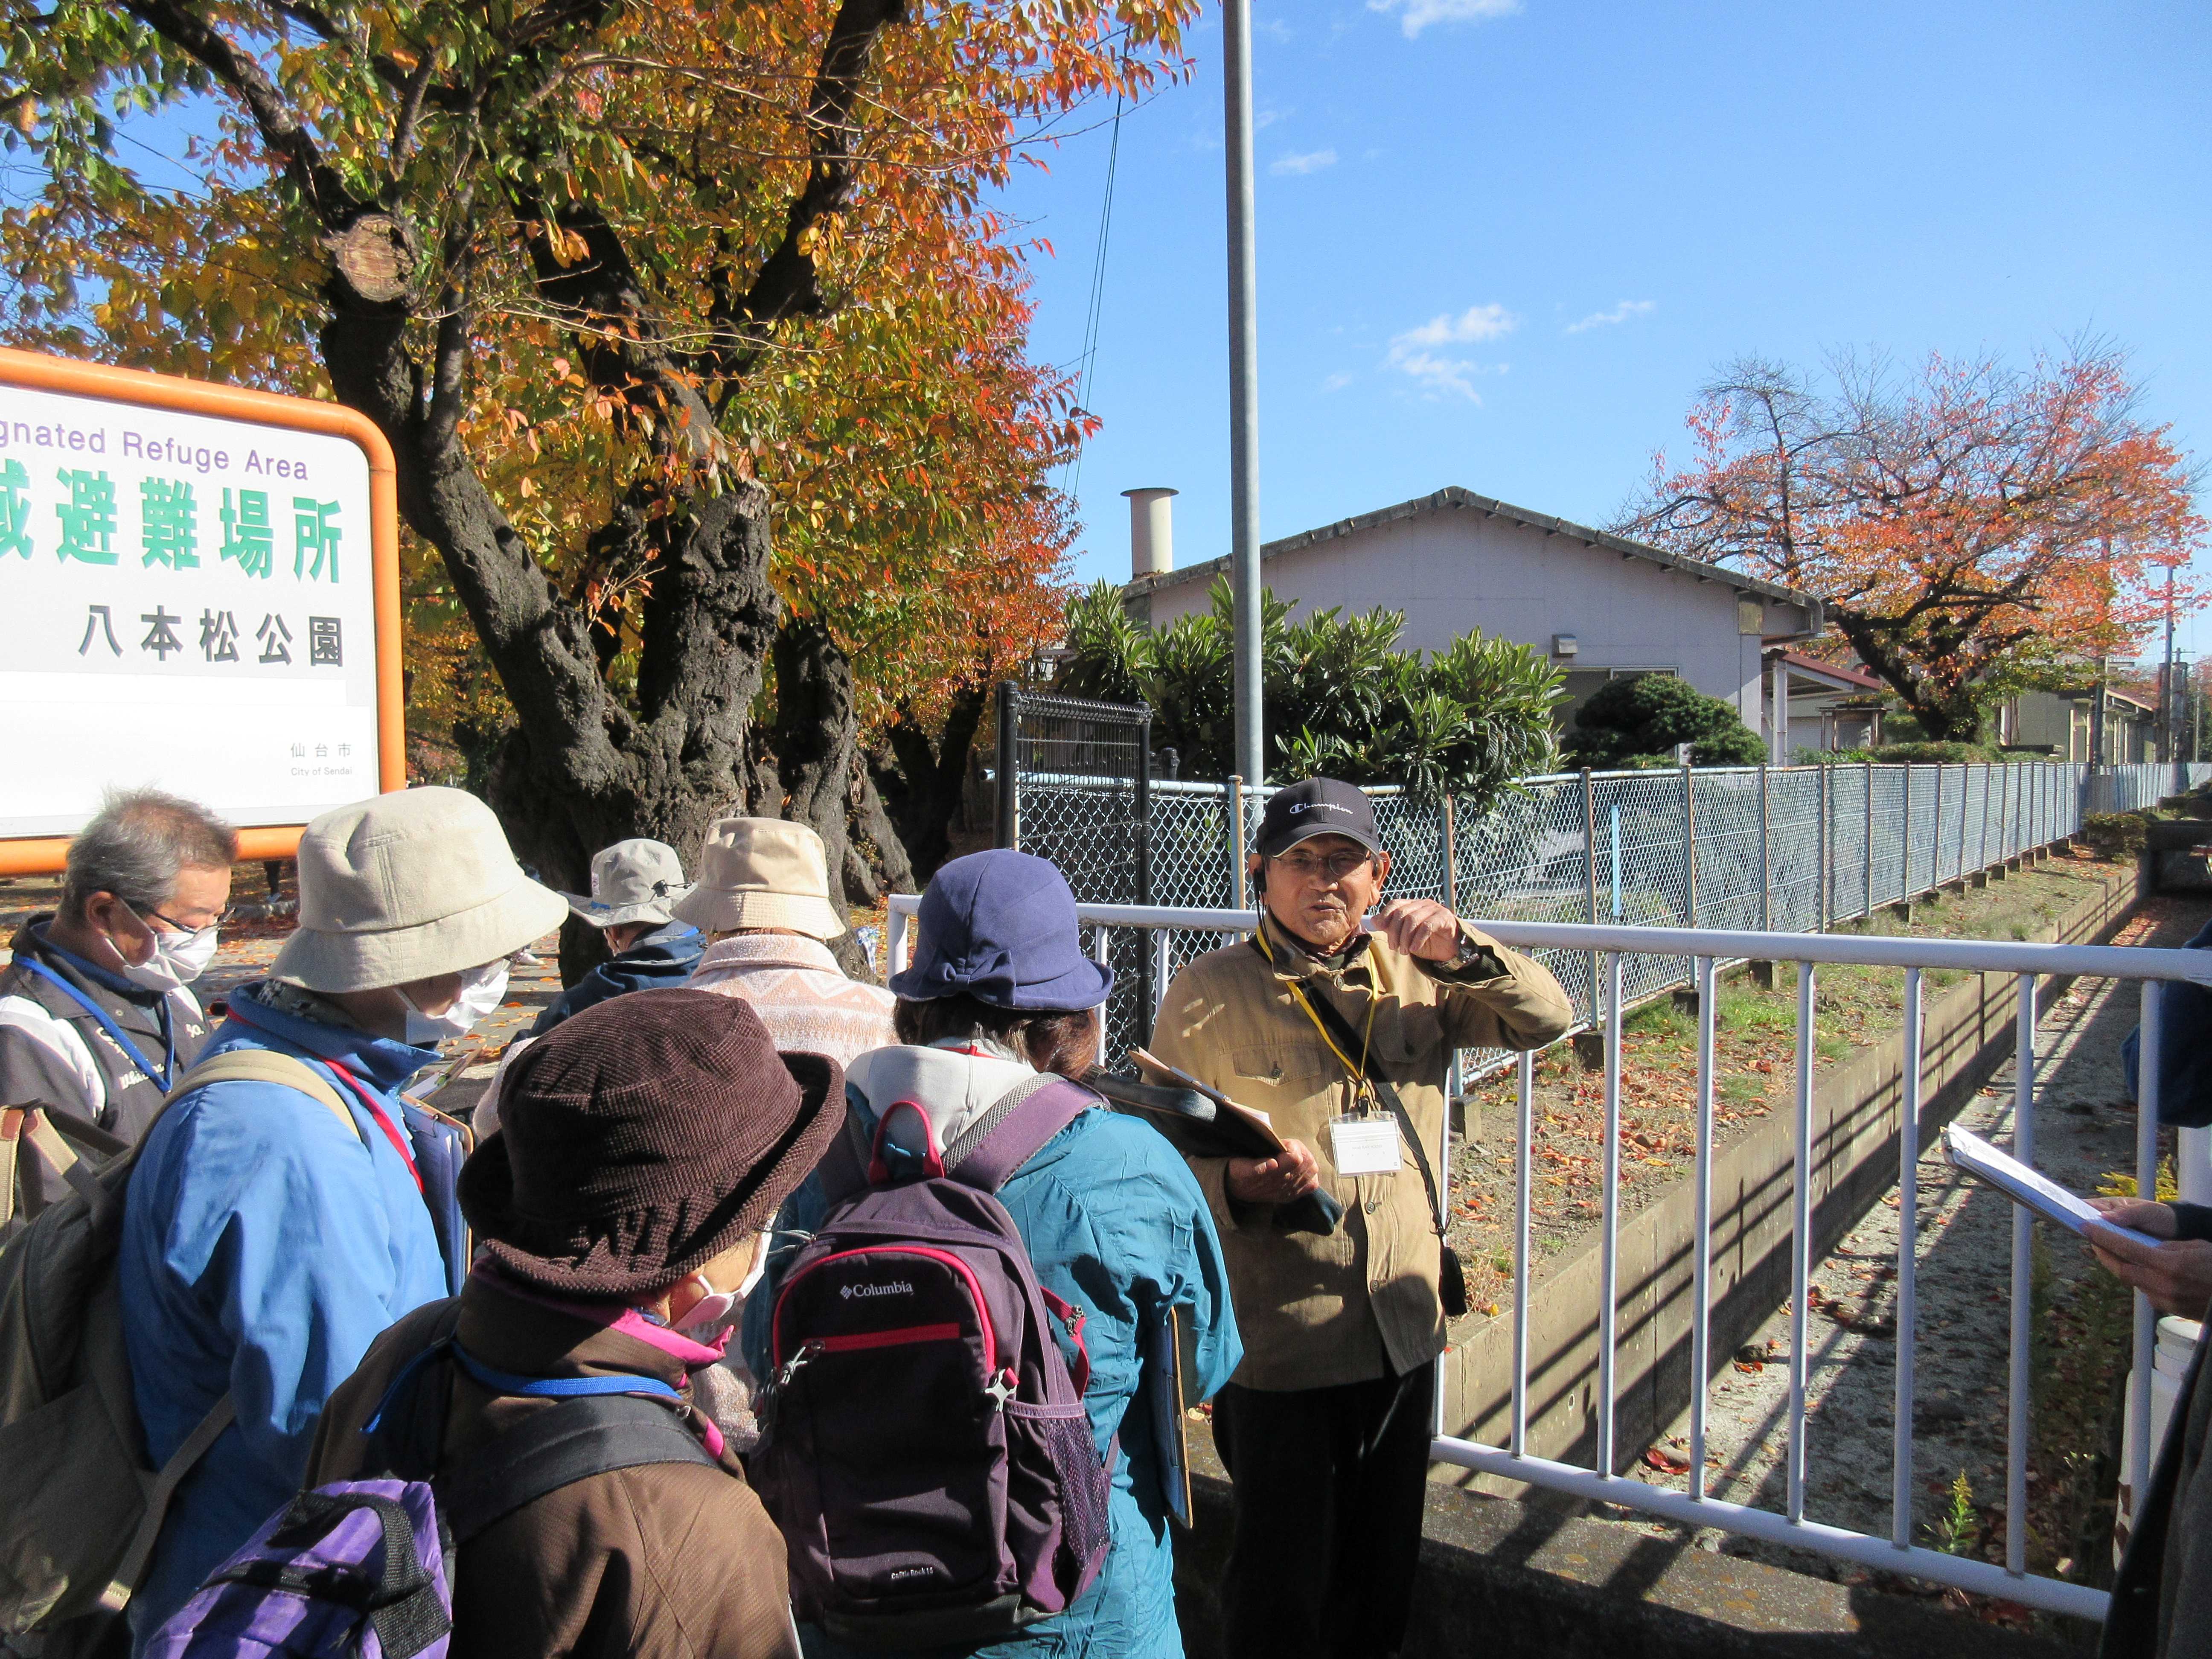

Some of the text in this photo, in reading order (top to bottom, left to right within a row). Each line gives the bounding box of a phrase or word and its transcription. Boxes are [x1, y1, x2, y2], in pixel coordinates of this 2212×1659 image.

[123, 431, 230, 474] Refuge
[244, 449, 309, 481] Area
[78, 604, 343, 667] 八本松公園
[290, 742, 352, 758] 仙台市
[291, 766, 353, 777] City of Sendai
[1289, 803, 1353, 814] Champion
[853, 1281, 914, 1297] Columbia
